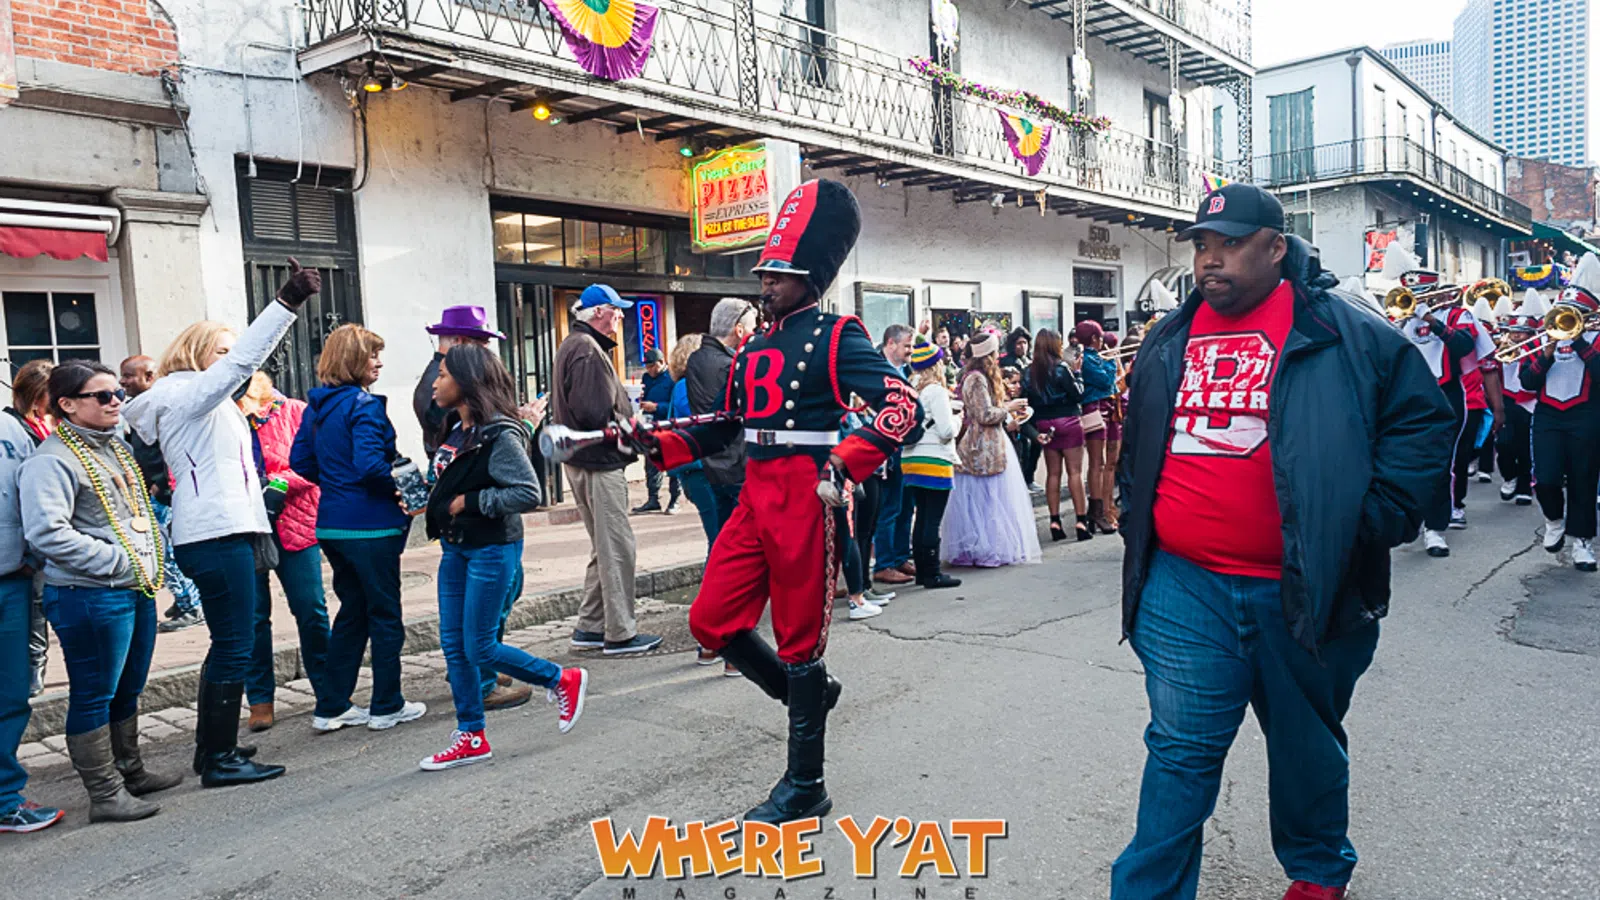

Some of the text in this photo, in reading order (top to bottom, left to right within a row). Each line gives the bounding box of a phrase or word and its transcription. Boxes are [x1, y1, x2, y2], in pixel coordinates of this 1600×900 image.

[700, 166, 731, 181] Vieux
[702, 169, 769, 208] PIZZA
[703, 221, 721, 236] PIZZA
[733, 217, 747, 231] THE
[747, 215, 768, 228] SLICE
[715, 201, 759, 220] EXPRESS
[640, 304, 656, 361] OPE
[744, 348, 785, 420] B
